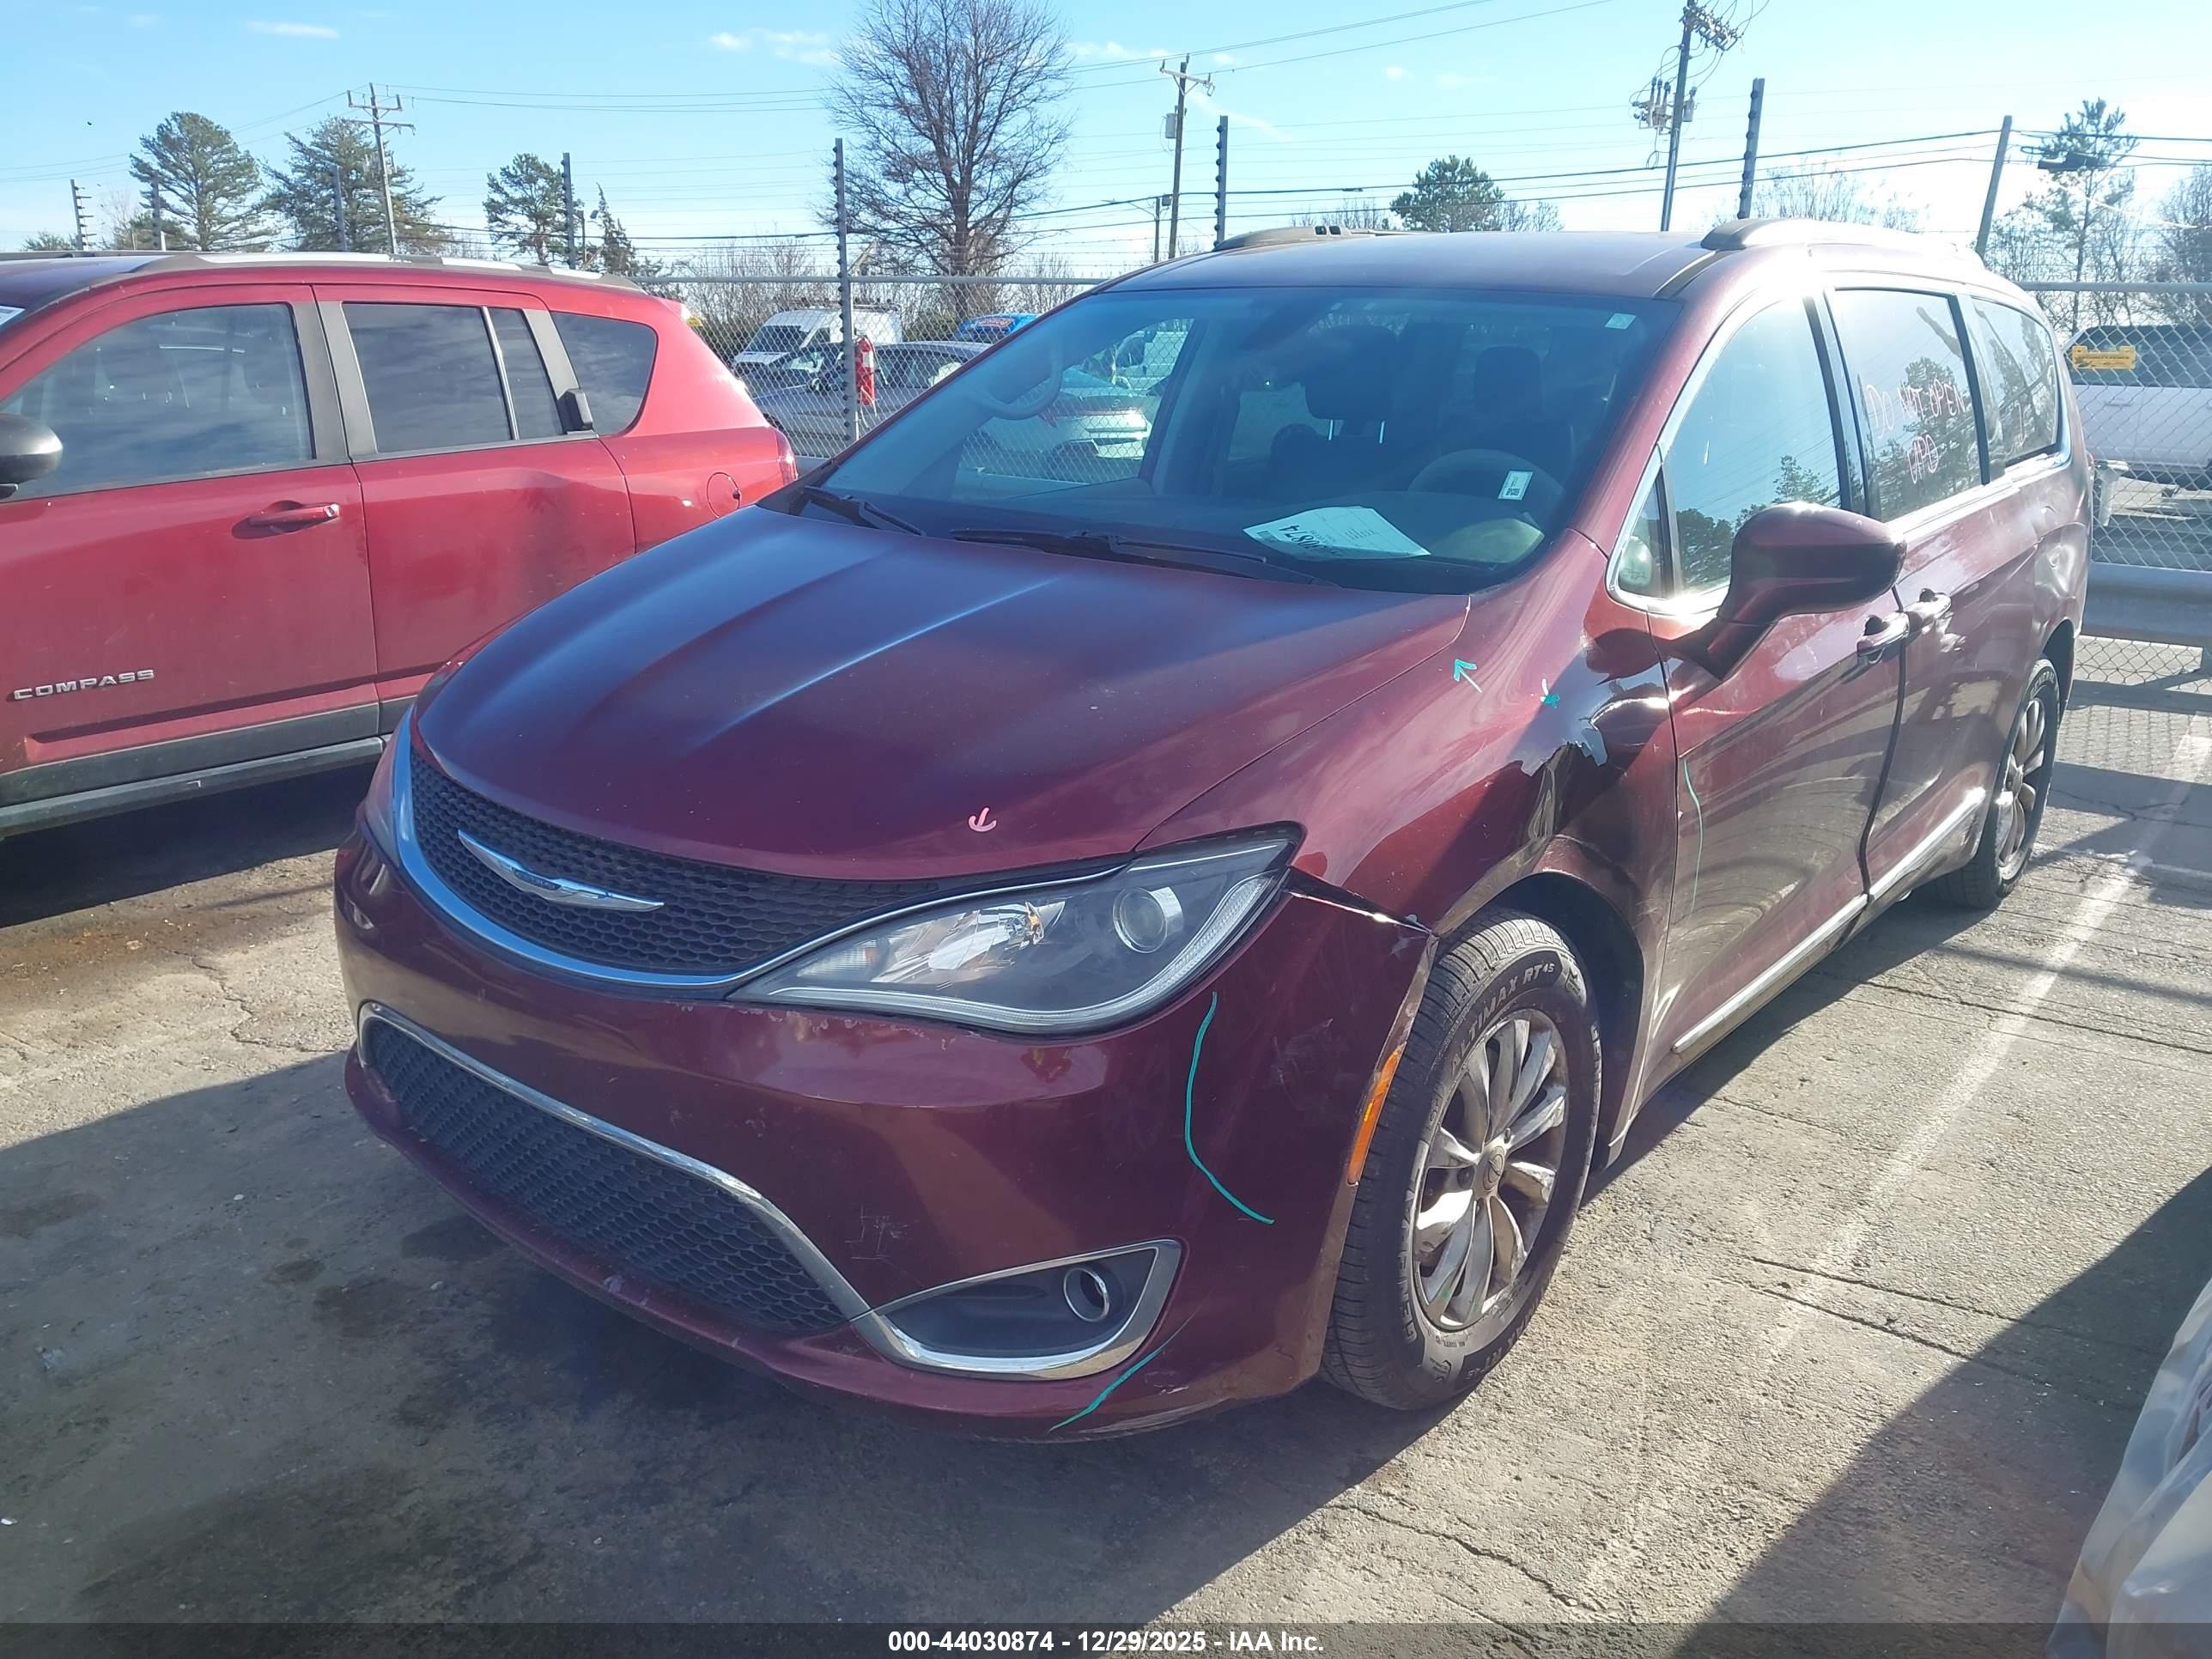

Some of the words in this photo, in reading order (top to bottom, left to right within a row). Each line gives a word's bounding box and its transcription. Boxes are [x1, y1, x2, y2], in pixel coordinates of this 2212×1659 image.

[1866, 384, 1894, 440] DO
[1929, 378, 1966, 417] OPEN
[14, 669, 155, 700] COMPASS
